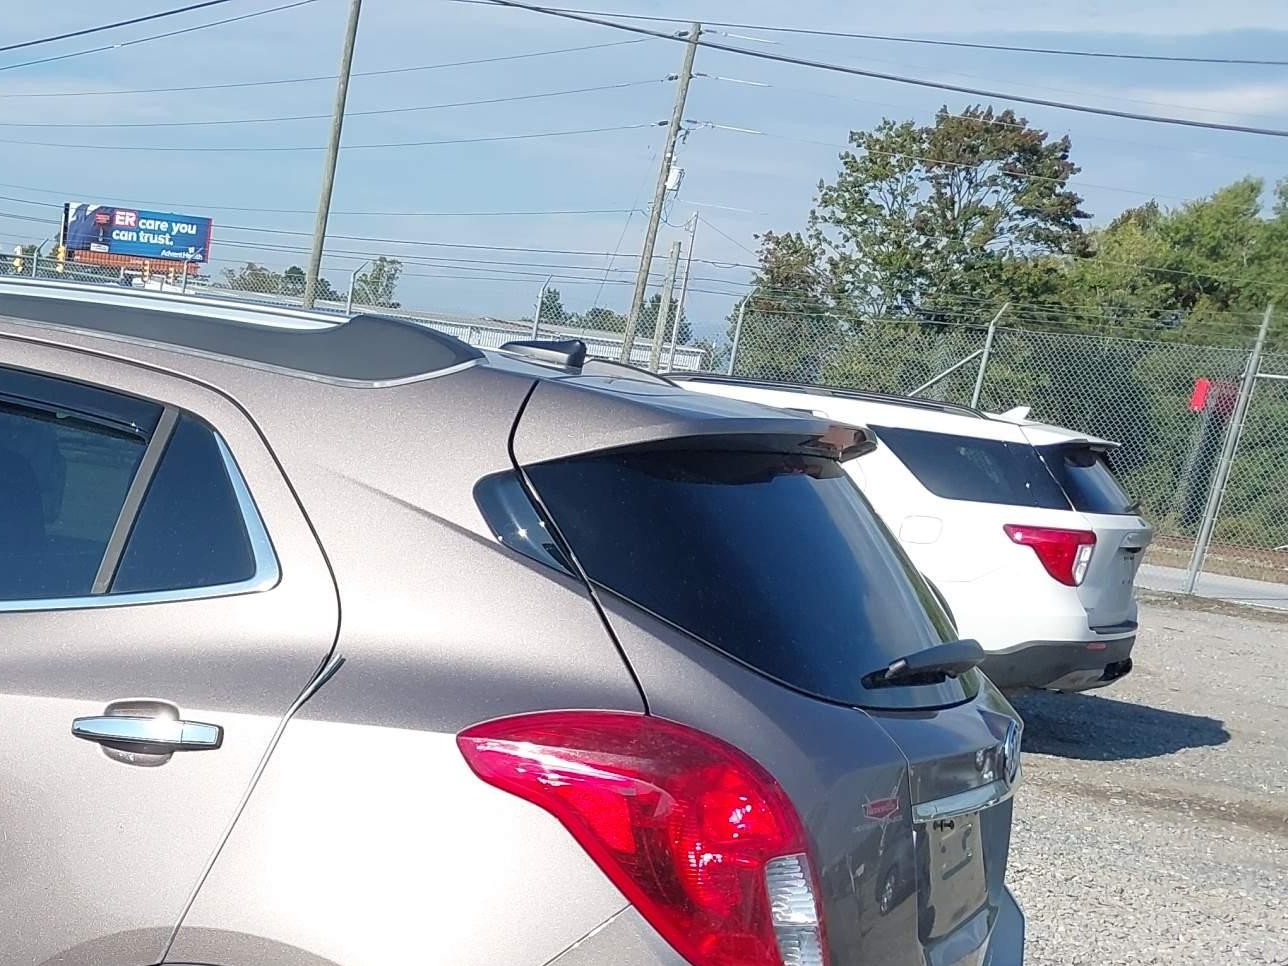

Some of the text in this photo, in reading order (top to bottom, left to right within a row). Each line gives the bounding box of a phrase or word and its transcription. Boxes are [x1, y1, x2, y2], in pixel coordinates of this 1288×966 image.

[115, 211, 136, 226] ER
[138, 219, 168, 231] care
[171, 222, 197, 235] you
[112, 229, 174, 246] can trust.
